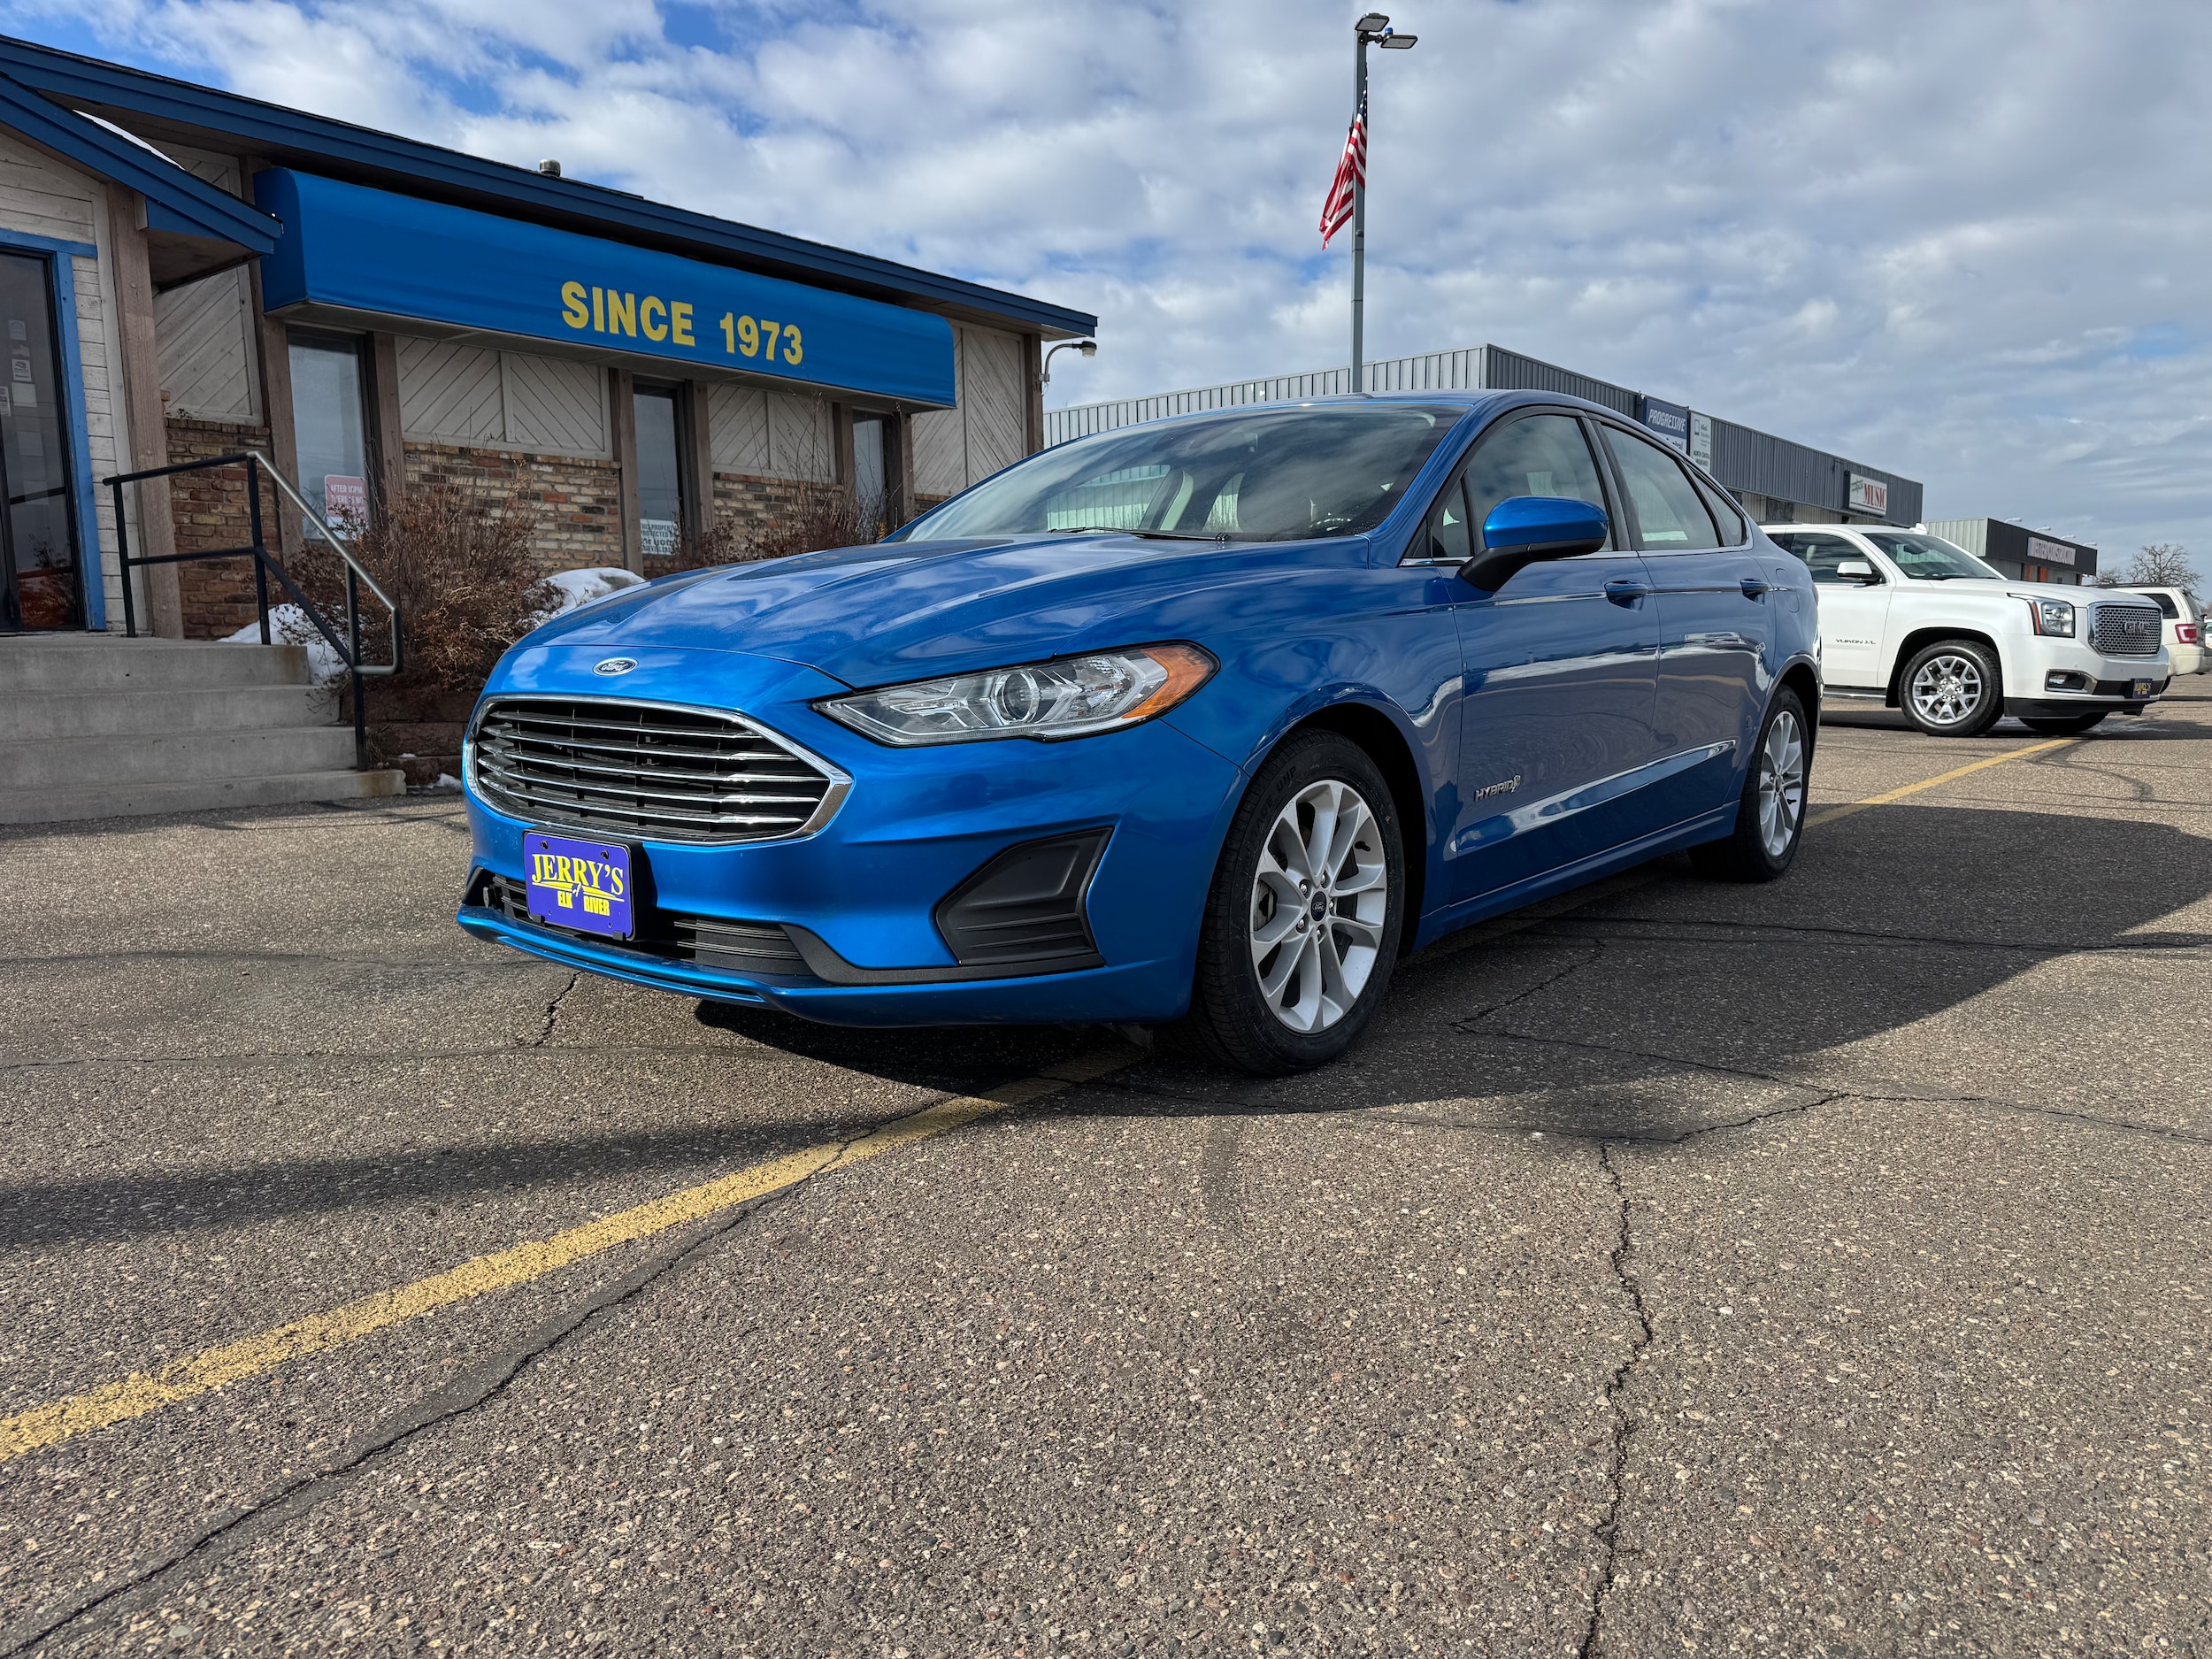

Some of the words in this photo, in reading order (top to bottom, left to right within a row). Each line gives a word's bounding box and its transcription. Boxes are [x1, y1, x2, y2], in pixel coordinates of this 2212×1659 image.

[561, 280, 695, 348] SINCE
[719, 311, 803, 365] 1973
[1647, 409, 1686, 432] PROGRESSIVE
[330, 484, 347, 493] AFTER
[1863, 483, 1886, 509] MUSIC
[2124, 621, 2149, 634] GMC
[1275, 764, 1297, 795] UHP
[1475, 780, 1514, 802] HYBRID
[531, 853, 625, 895] JERRY'S
[557, 890, 573, 909] ELK
[583, 895, 611, 917] RIVER
